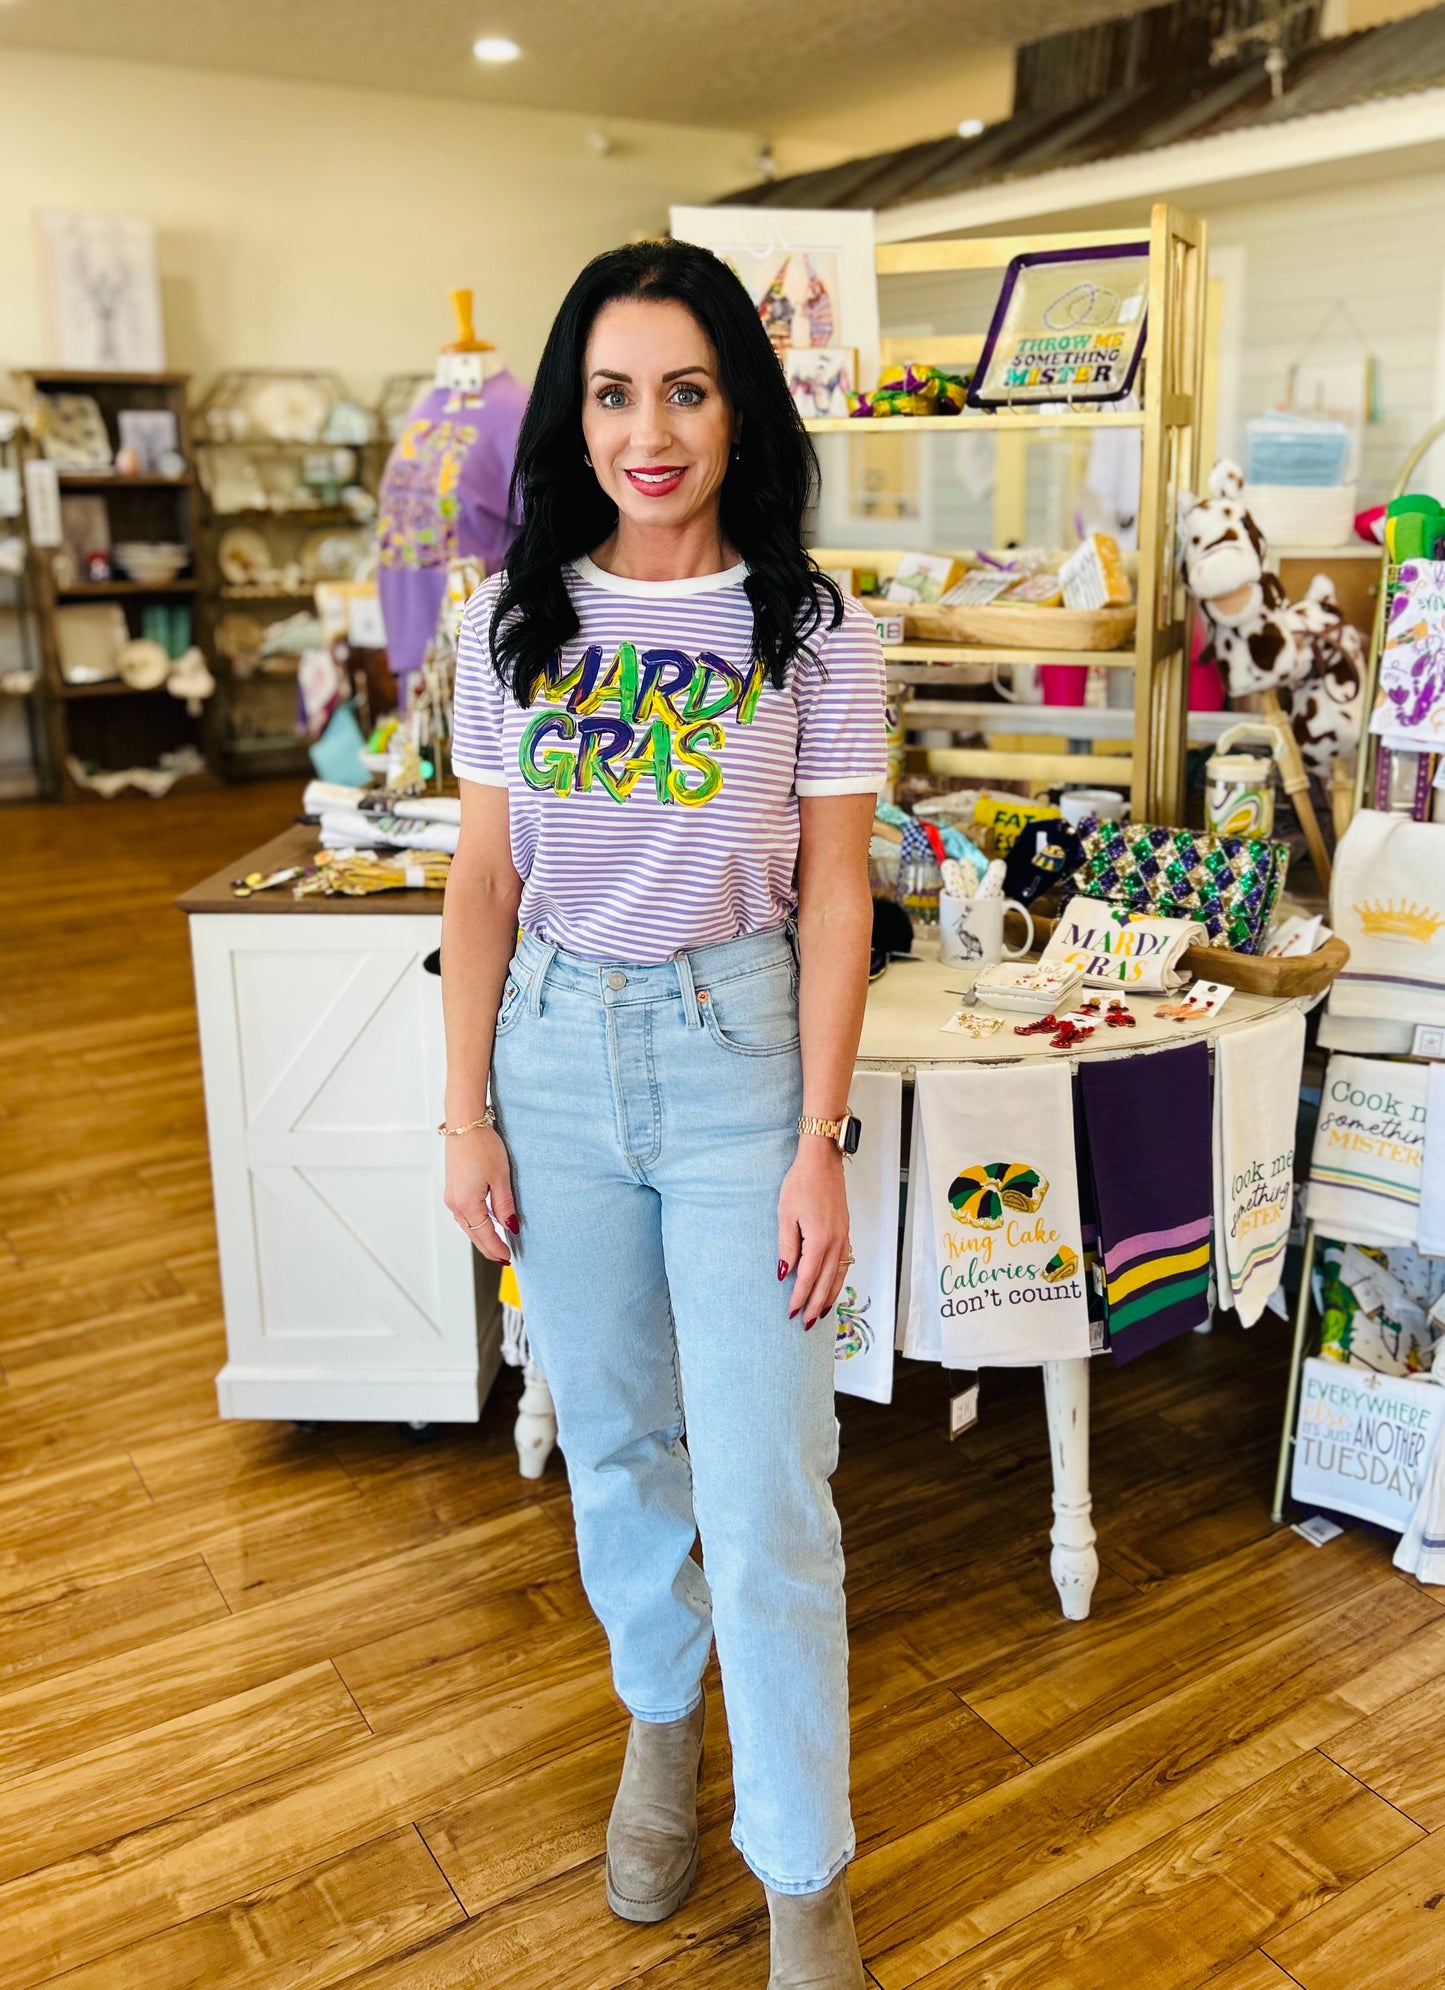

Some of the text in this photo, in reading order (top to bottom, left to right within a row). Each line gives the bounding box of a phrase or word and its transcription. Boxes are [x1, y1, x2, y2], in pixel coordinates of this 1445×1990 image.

[1012, 349, 1120, 366] SOMETHING
[1017, 332, 1126, 353] THROW ME
[1003, 365, 1113, 387] MISTER
[527, 641, 766, 730] MARDI
[518, 708, 726, 808] GRAS
[1061, 922, 1172, 957] MARDI
[1064, 951, 1148, 983] GRAS
[1331, 1080, 1404, 1117] Cook
[1319, 1112, 1426, 1147] somethin
[1327, 1128, 1421, 1168] MISTER
[943, 1217, 1061, 1264] King Cake
[939, 1257, 1042, 1296] Calories
[940, 1280, 1082, 1318] don't count
[1306, 1378, 1432, 1431] EVERYWHERE
[1353, 1415, 1426, 1469] ANOTHER
[1302, 1436, 1416, 1502] TUESDAY
